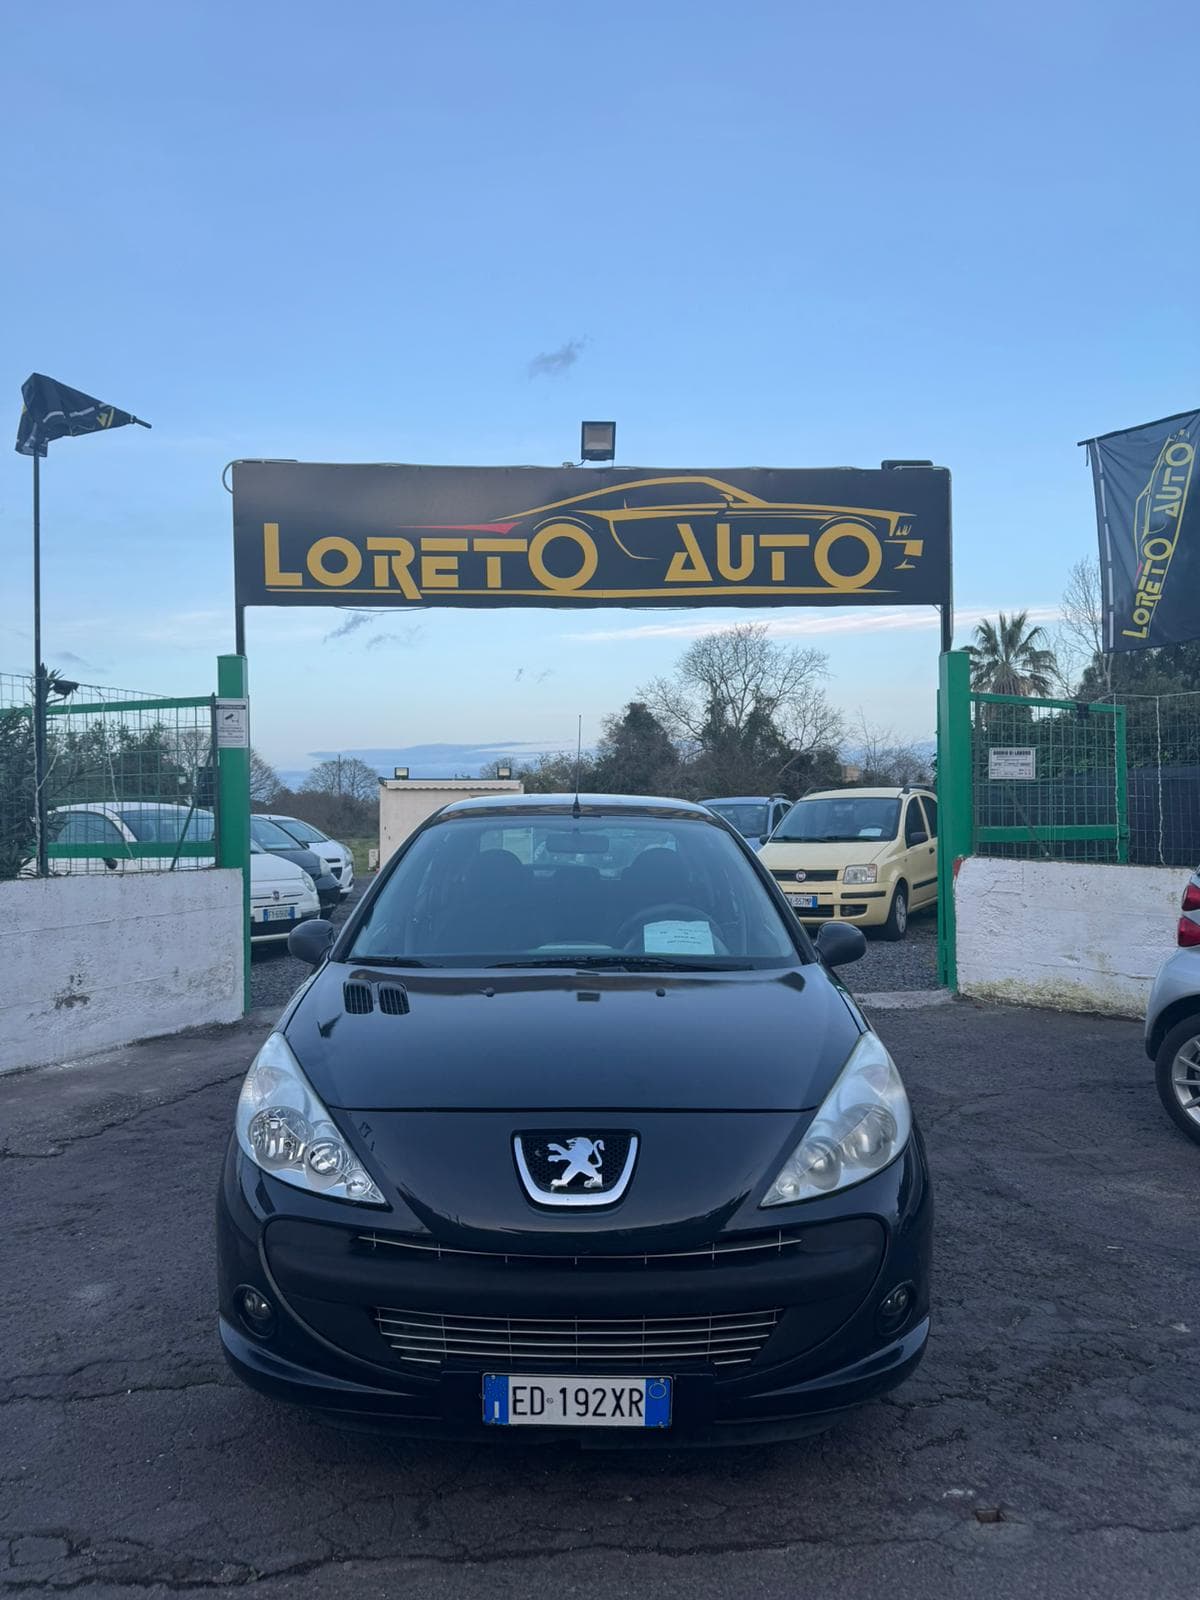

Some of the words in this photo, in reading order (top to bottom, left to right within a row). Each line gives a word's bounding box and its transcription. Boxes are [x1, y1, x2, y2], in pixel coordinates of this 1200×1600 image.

[264, 522, 599, 600] LORETO
[663, 522, 883, 590] AUTO
[1121, 537, 1173, 639] LORETO
[1153, 442, 1193, 519] AUTO
[511, 1386, 545, 1416] ED
[559, 1387, 644, 1417] 192XR
